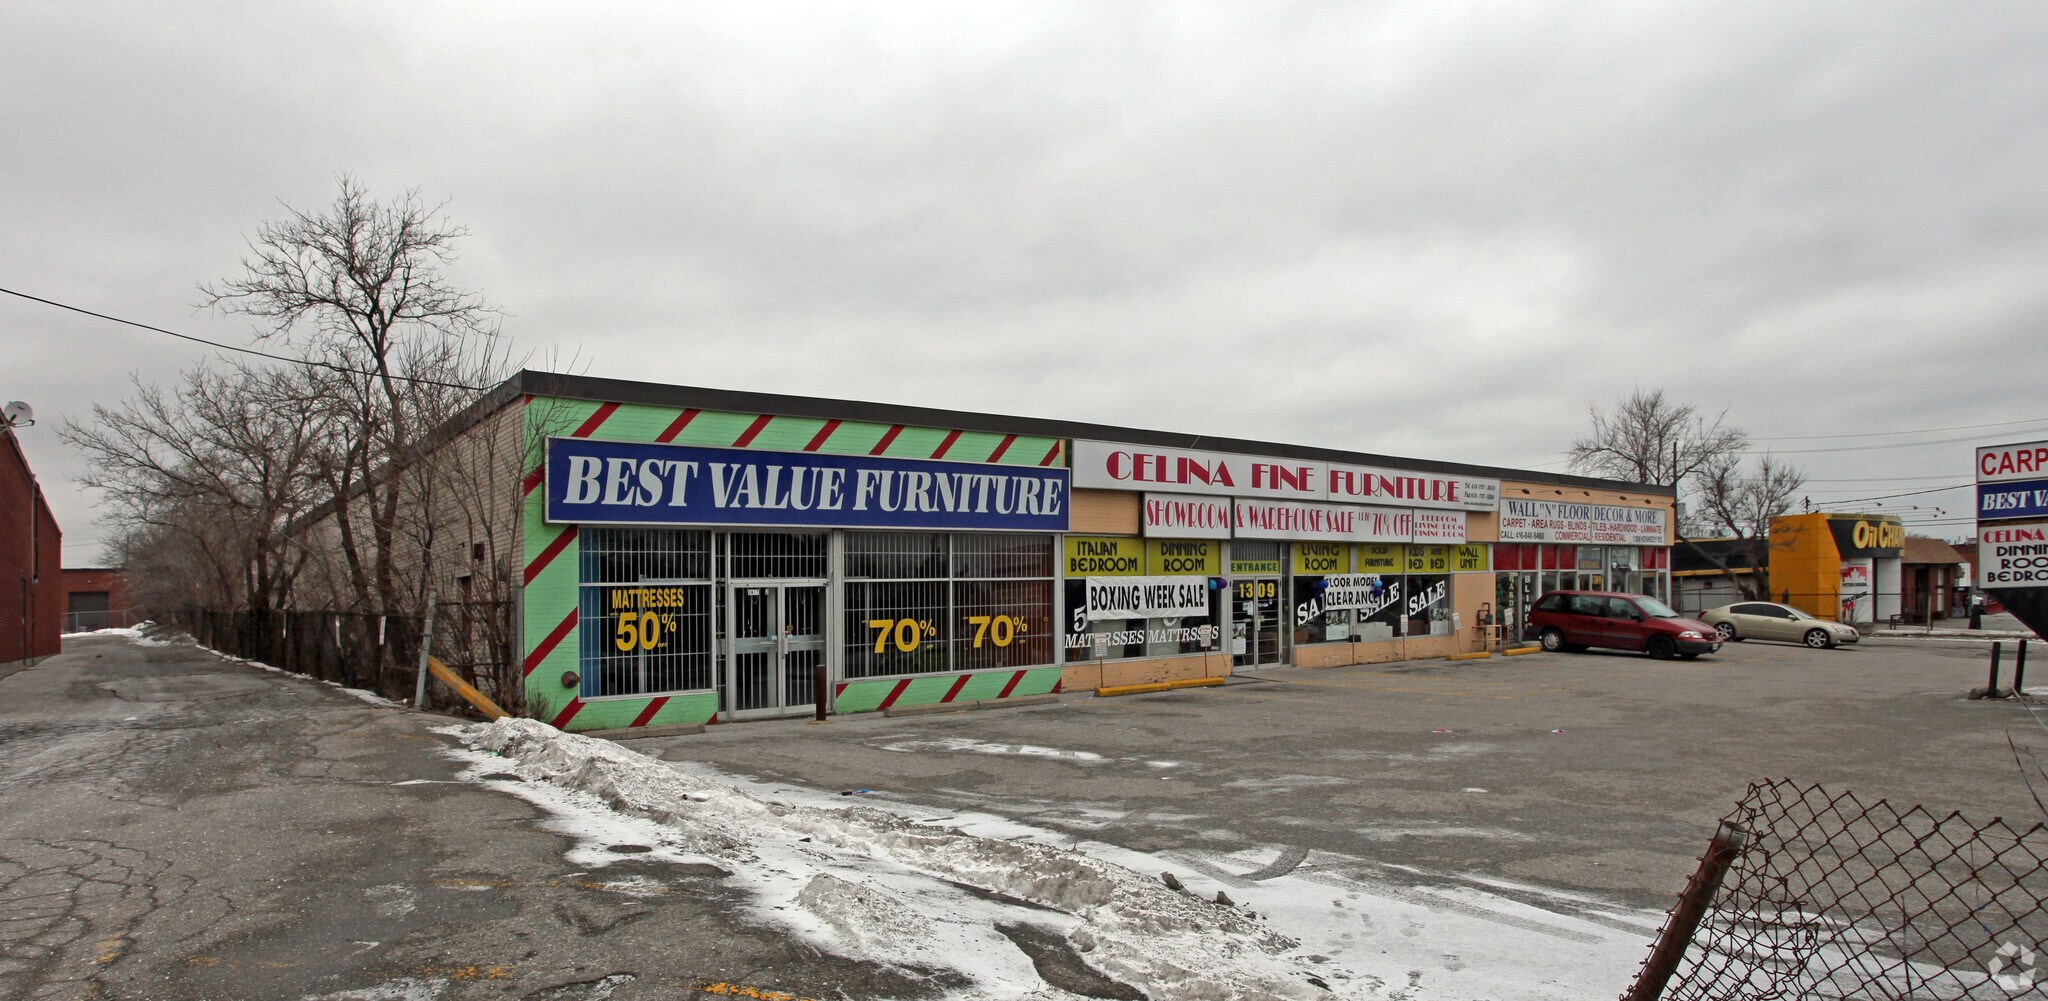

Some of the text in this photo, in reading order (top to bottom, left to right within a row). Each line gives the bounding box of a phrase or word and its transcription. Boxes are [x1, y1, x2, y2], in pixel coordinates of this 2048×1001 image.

[1981, 448, 2048, 476] CARP
[1106, 451, 1235, 487] CELINA
[1251, 463, 1315, 492] FINE
[1329, 469, 1460, 502] FURNITURE
[563, 456, 1062, 515] BEST VALUE FURNITURE
[1982, 490, 2030, 511] BEST
[1146, 500, 1229, 529] SHOWROOM
[1235, 504, 1244, 528] &
[1248, 505, 1322, 532] WAREHOUSE
[1326, 509, 1354, 533] SALE
[1372, 513, 1391, 536] 70%
[1393, 513, 1412, 536] OFF
[1421, 514, 1457, 523] BEDROOM
[1508, 501, 1538, 517] WALL
[1558, 504, 1589, 520] FLOOR
[1594, 506, 1624, 522] DECOR
[1625, 509, 1632, 522] &
[1634, 510, 1657, 524] MORE
[1414, 522, 1464, 531] LIVING ROOM
[1414, 529, 1439, 537] DINING
[1502, 518, 1526, 528] CARPET
[1531, 519, 1548, 529] AREA
[1549, 520, 1563, 530] RUGS
[1567, 520, 1587, 531] BLINDS
[1592, 522, 1606, 531] TILES
[1610, 523, 1637, 533] HARDWOOD
[1641, 525, 1662, 533] LAMINATE
[1555, 531, 1590, 542] COMMERCIAL
[1594, 533, 1626, 542] RESIDENTIAL
[1983, 528, 2045, 544] CELINA
[1077, 541, 1117, 555] ITALIAN
[1161, 542, 1207, 556] DINNING
[1302, 544, 1339, 556] LIVING
[1409, 546, 1424, 556] KIDS
[1458, 547, 1478, 558] WALL
[1070, 557, 1138, 572] BEDROOM
[1164, 558, 1204, 572] ROOM
[1231, 562, 1277, 572] ENTRANCE
[1304, 558, 1338, 570] ROOM
[1365, 558, 1394, 567] FURNITURE
[1409, 558, 1444, 569] BED BED
[1459, 558, 1477, 569] UNIT
[1987, 569, 2048, 583] BEDRO
[1090, 584, 1204, 611] BOXING WEEK SALE
[1239, 583, 1275, 598] 1309
[1409, 580, 1445, 616] SALE
[612, 588, 684, 609] MATTRESSES
[616, 611, 676, 651] 50%
[869, 618, 936, 654] 70%
[968, 615, 1027, 648] 70%
[1149, 625, 1219, 644] MATTRSSS
[1065, 629, 1145, 649] MATRSSES
